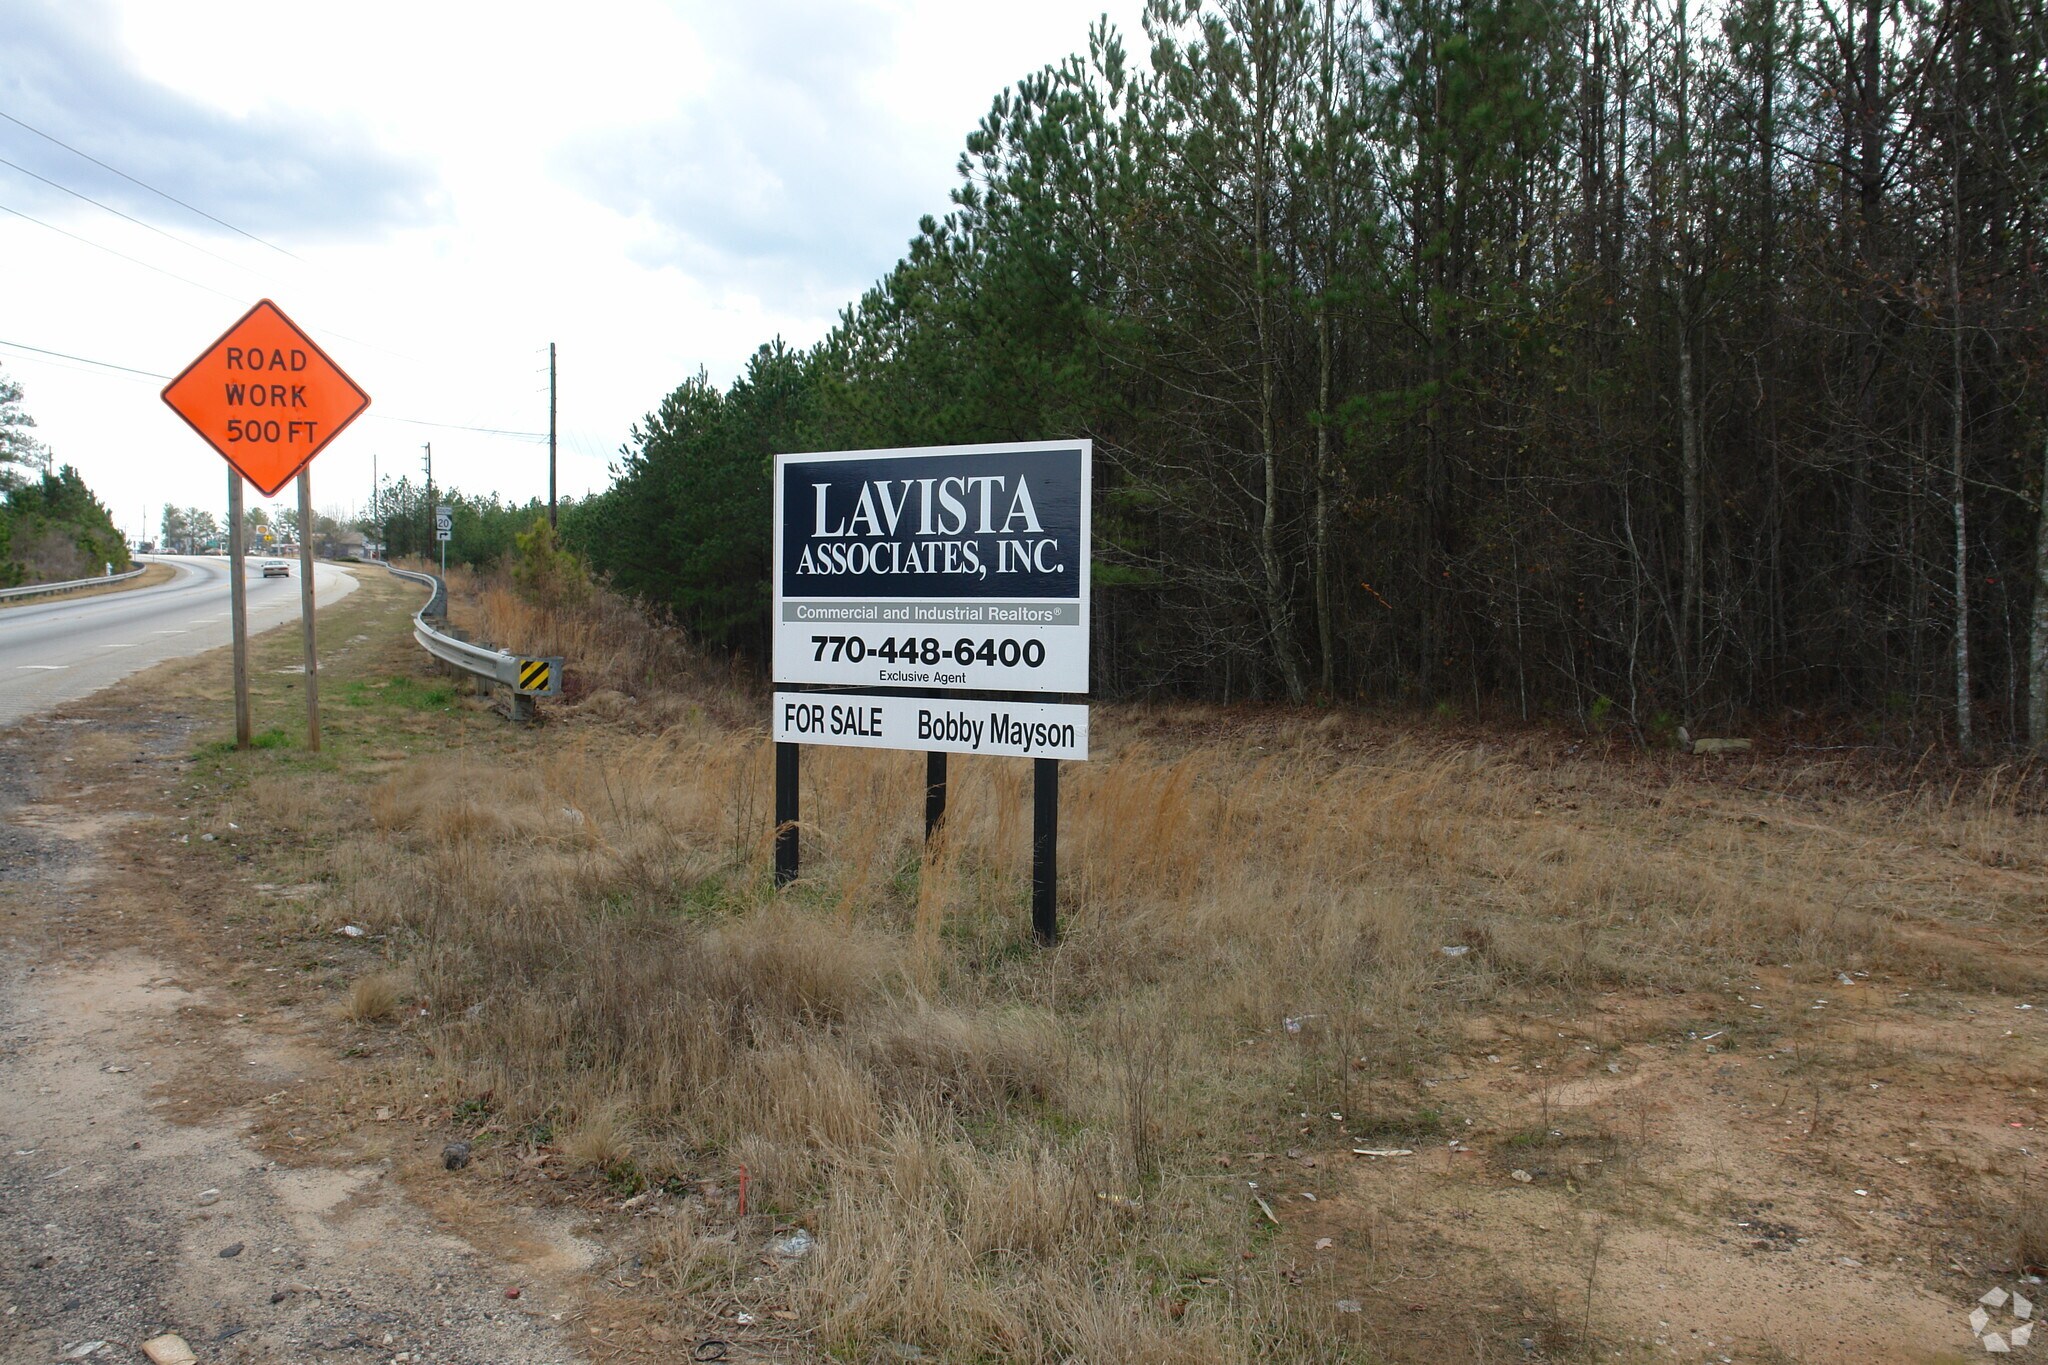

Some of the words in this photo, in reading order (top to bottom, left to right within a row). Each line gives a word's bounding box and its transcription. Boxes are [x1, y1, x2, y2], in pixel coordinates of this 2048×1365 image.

[227, 348, 307, 371] ROAD
[225, 383, 308, 407] WORK
[227, 419, 281, 442] 500
[289, 421, 318, 443] FT
[811, 474, 1044, 537] LAVISTA
[438, 519, 449, 527] 20
[796, 540, 986, 580] ASSOCIATES,
[996, 538, 1064, 573] INC.
[796, 605, 878, 619] Commercial
[883, 607, 910, 619] and
[914, 607, 983, 621] Industrial
[811, 636, 1046, 668] 770-448-6400
[879, 670, 929, 682] Exclusive
[933, 671, 966, 684] Agent
[784, 704, 824, 733] FOR
[830, 705, 882, 736] SALE
[918, 709, 984, 749] Bobby
[990, 713, 1075, 752] Mayson
